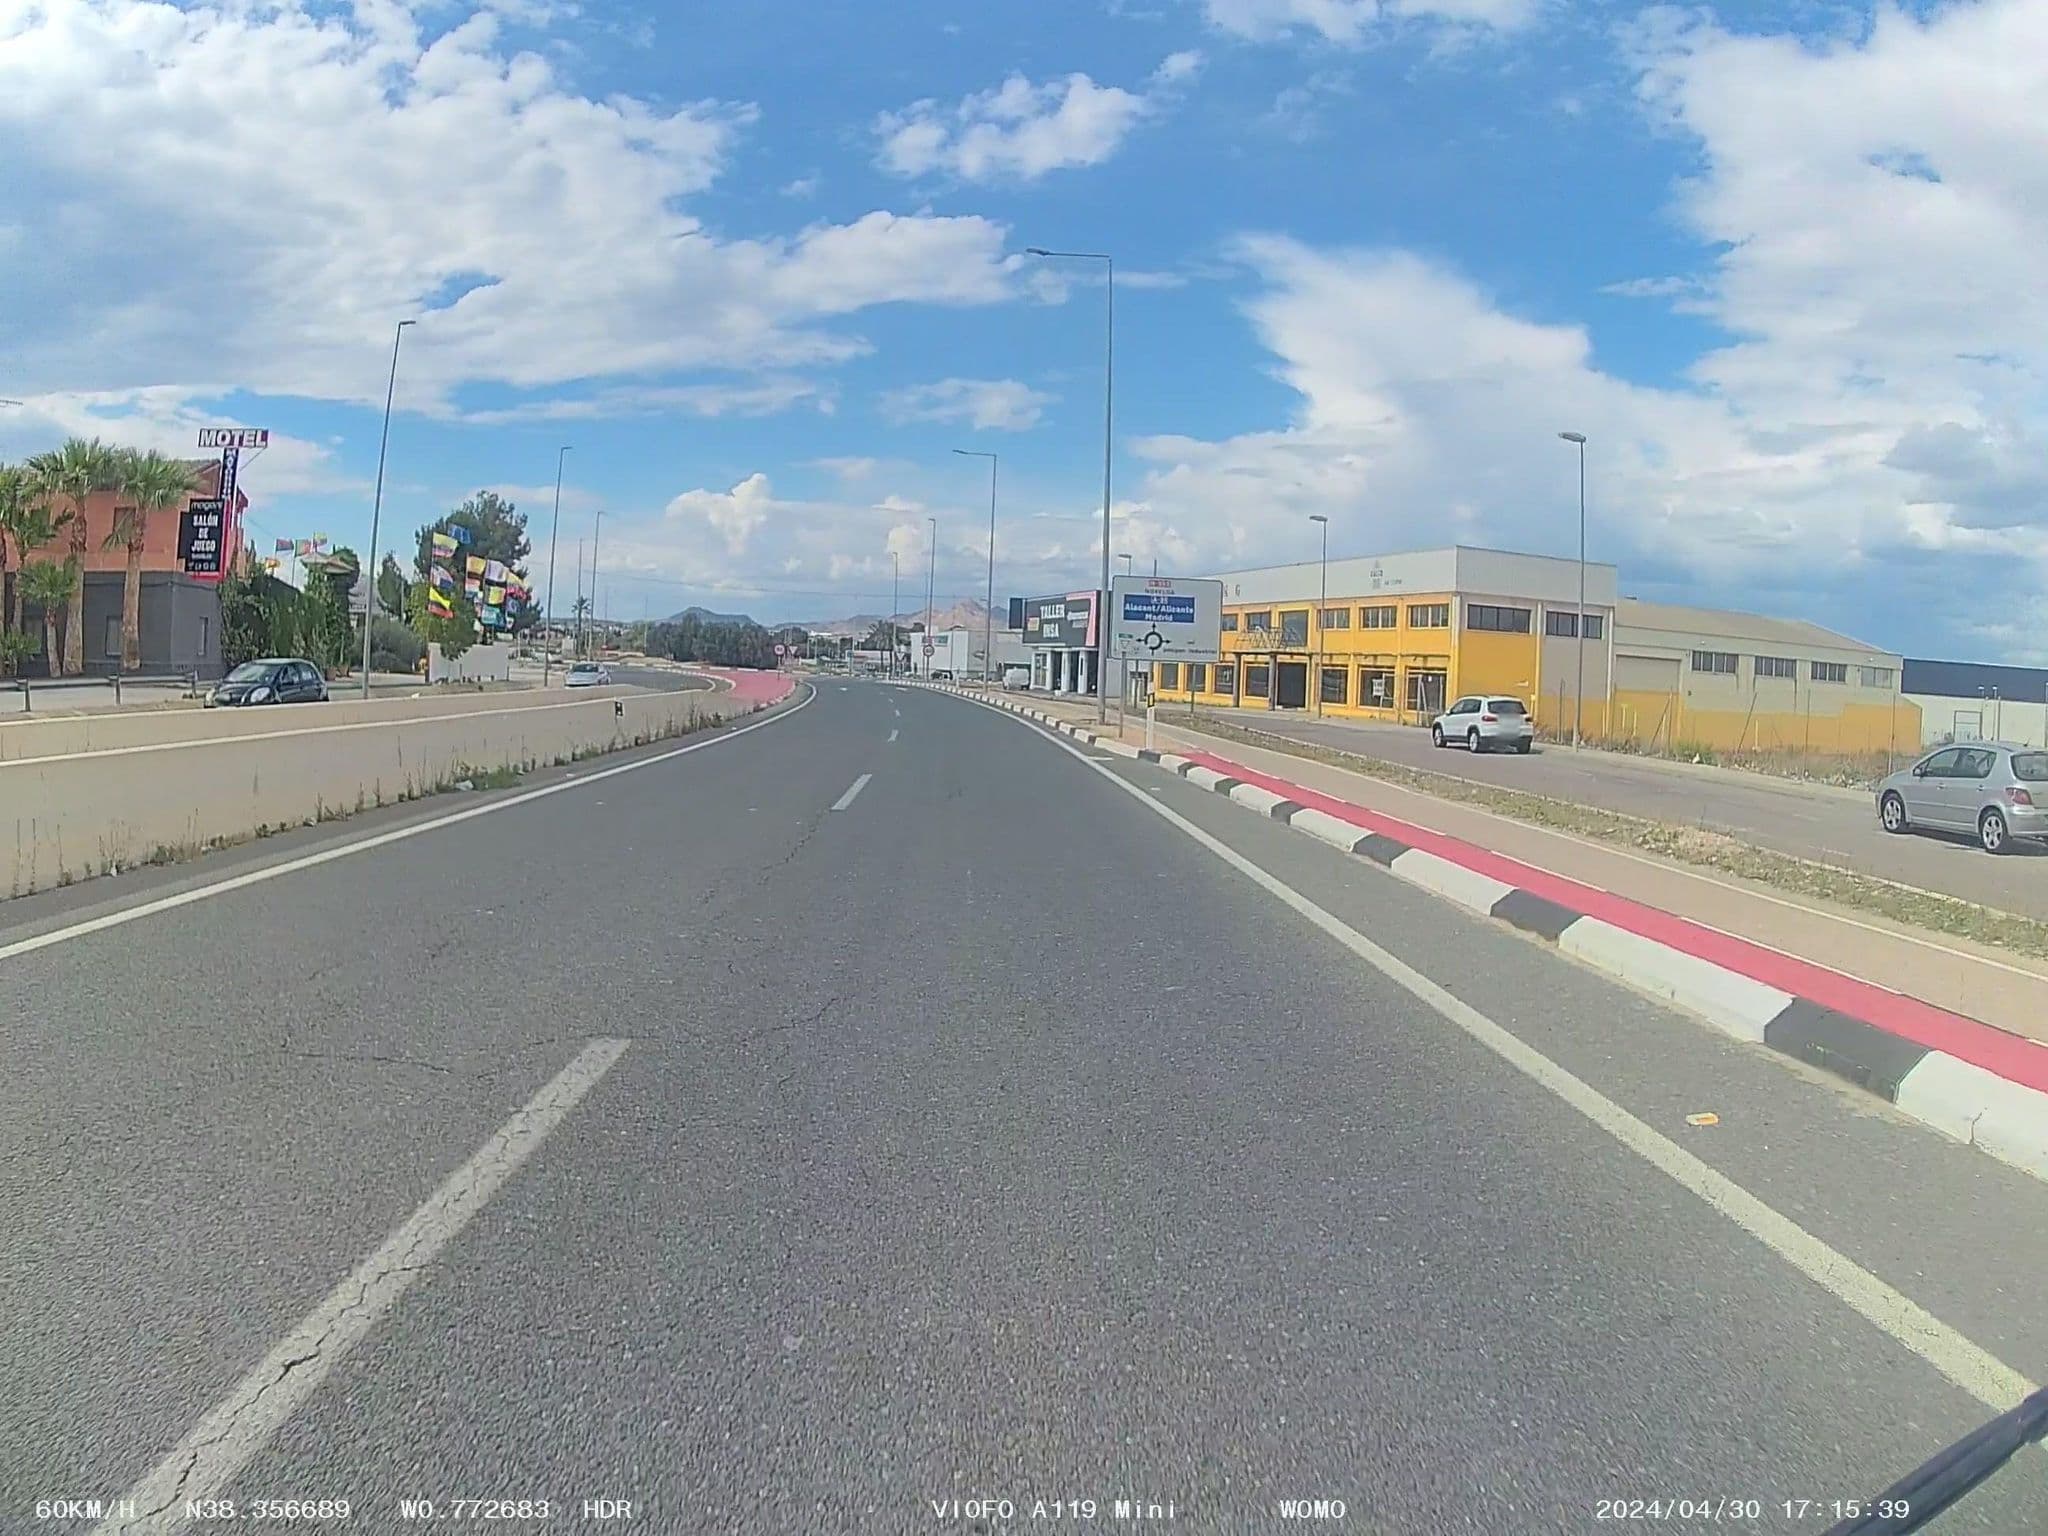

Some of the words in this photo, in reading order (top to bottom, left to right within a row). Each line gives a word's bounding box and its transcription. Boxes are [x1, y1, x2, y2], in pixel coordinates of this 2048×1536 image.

[199, 429, 266, 448] MOTEL
[193, 512, 218, 527] SALÓN
[198, 527, 209, 539] DE
[191, 540, 216, 552] JUEGO
[1040, 604, 1065, 620] TALLER
[1145, 613, 1173, 622] Madrid
